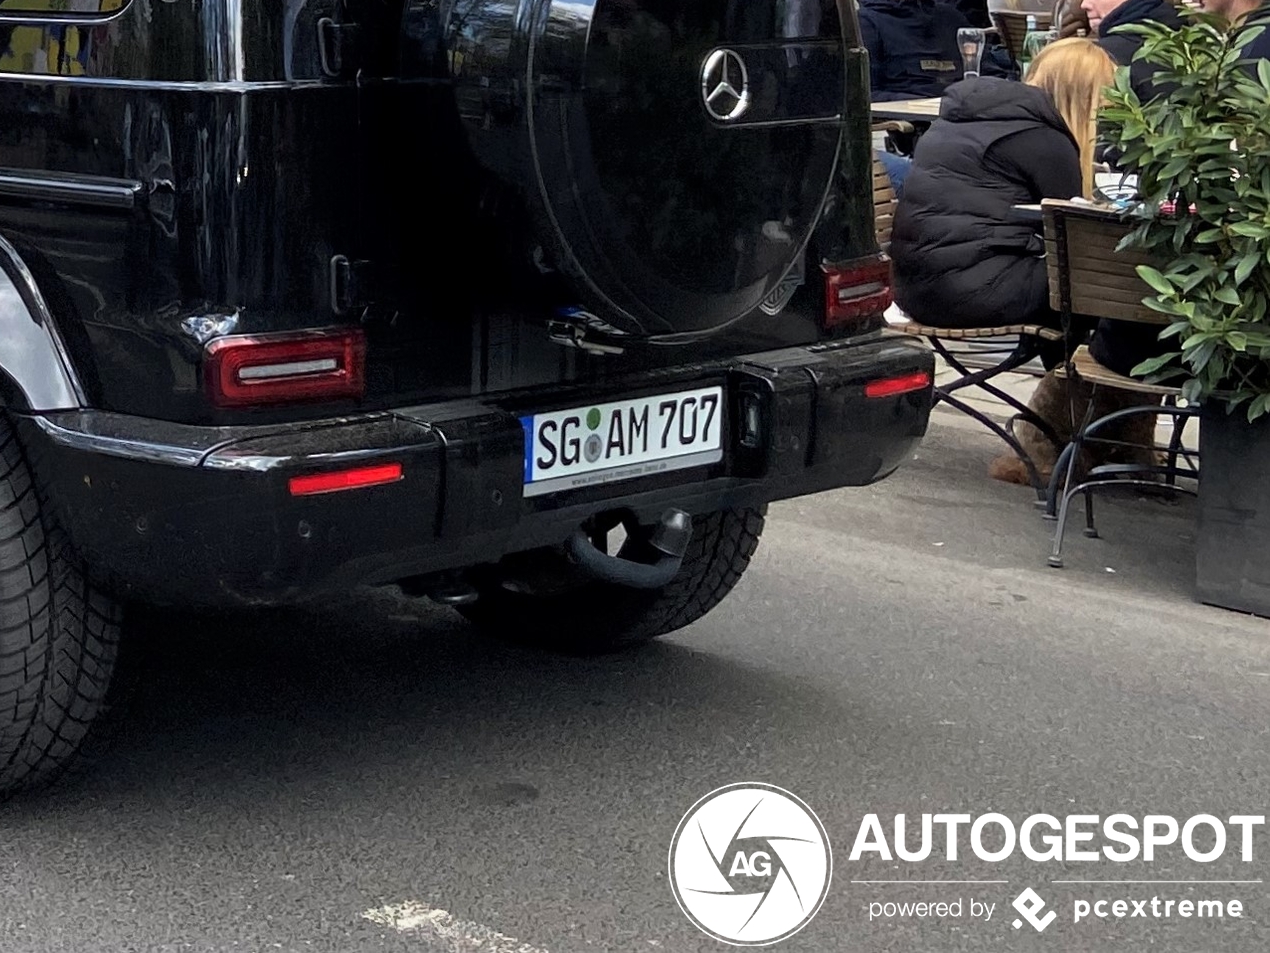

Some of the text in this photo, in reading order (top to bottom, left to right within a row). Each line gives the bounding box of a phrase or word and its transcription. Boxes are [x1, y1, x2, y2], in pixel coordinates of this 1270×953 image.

[536, 393, 719, 470] SG AM 707
